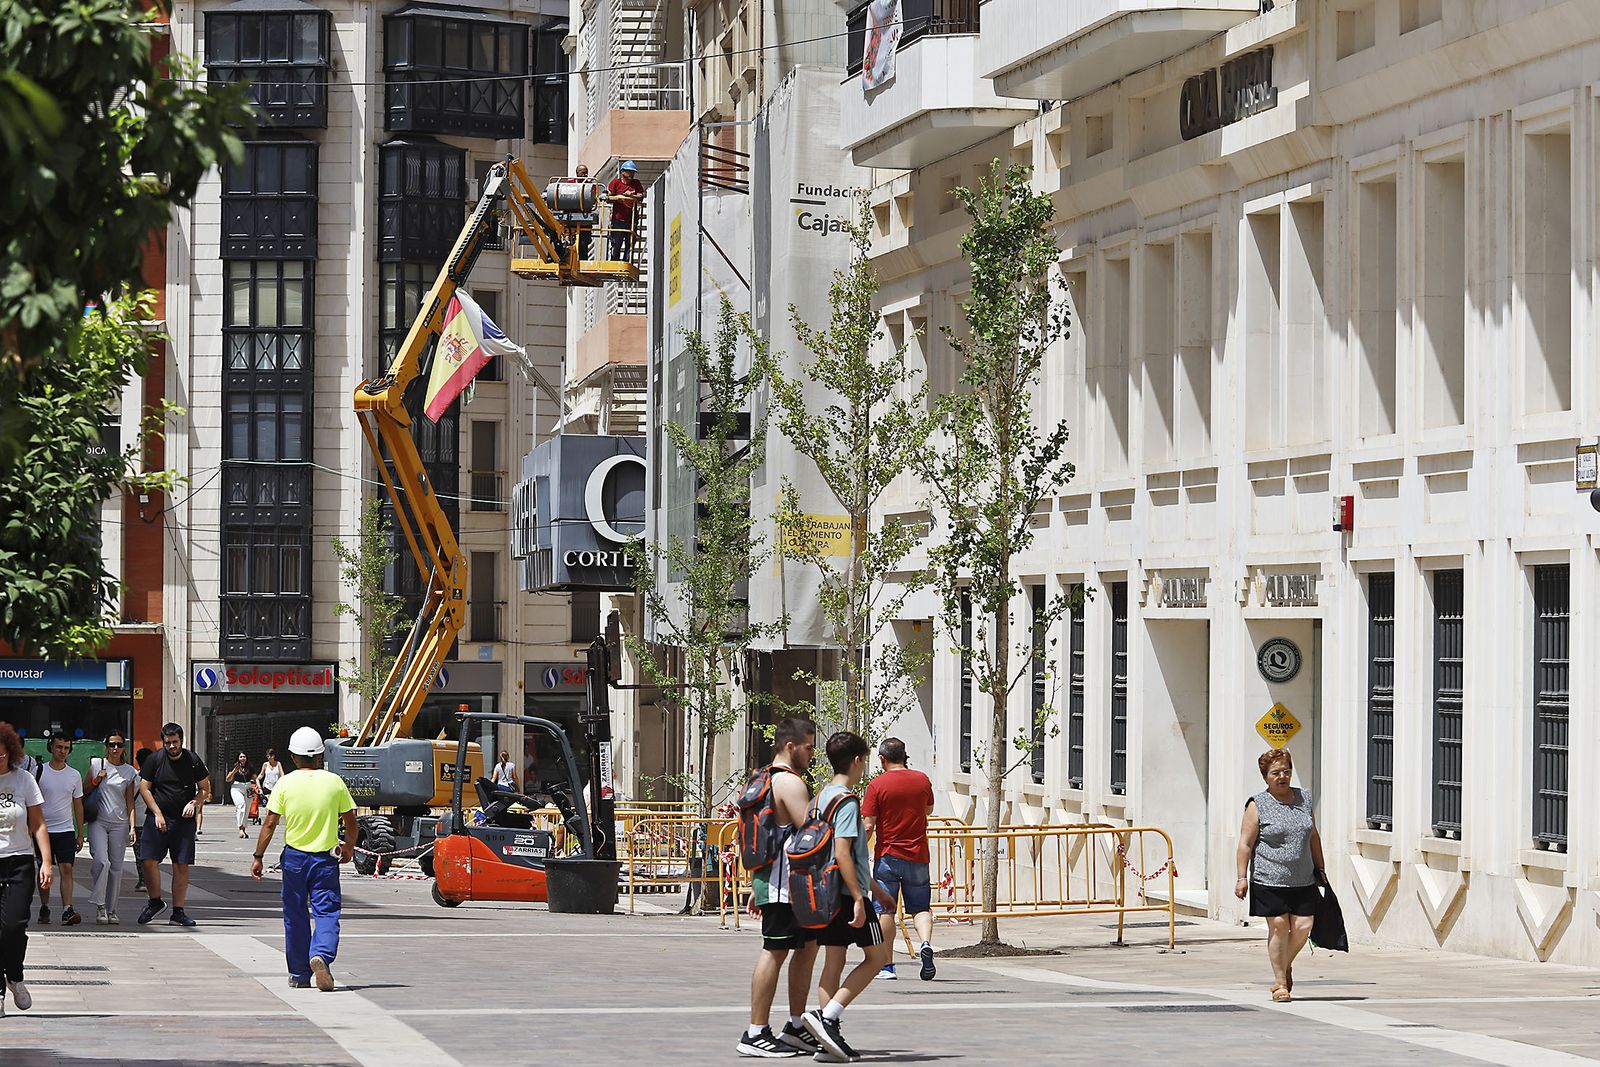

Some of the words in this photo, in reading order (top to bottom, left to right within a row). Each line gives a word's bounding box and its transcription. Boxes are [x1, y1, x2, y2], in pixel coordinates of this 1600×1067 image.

[0, 669, 44, 678] movistar
[226, 667, 331, 689] Soloptical
[514, 838, 534, 846] 20
